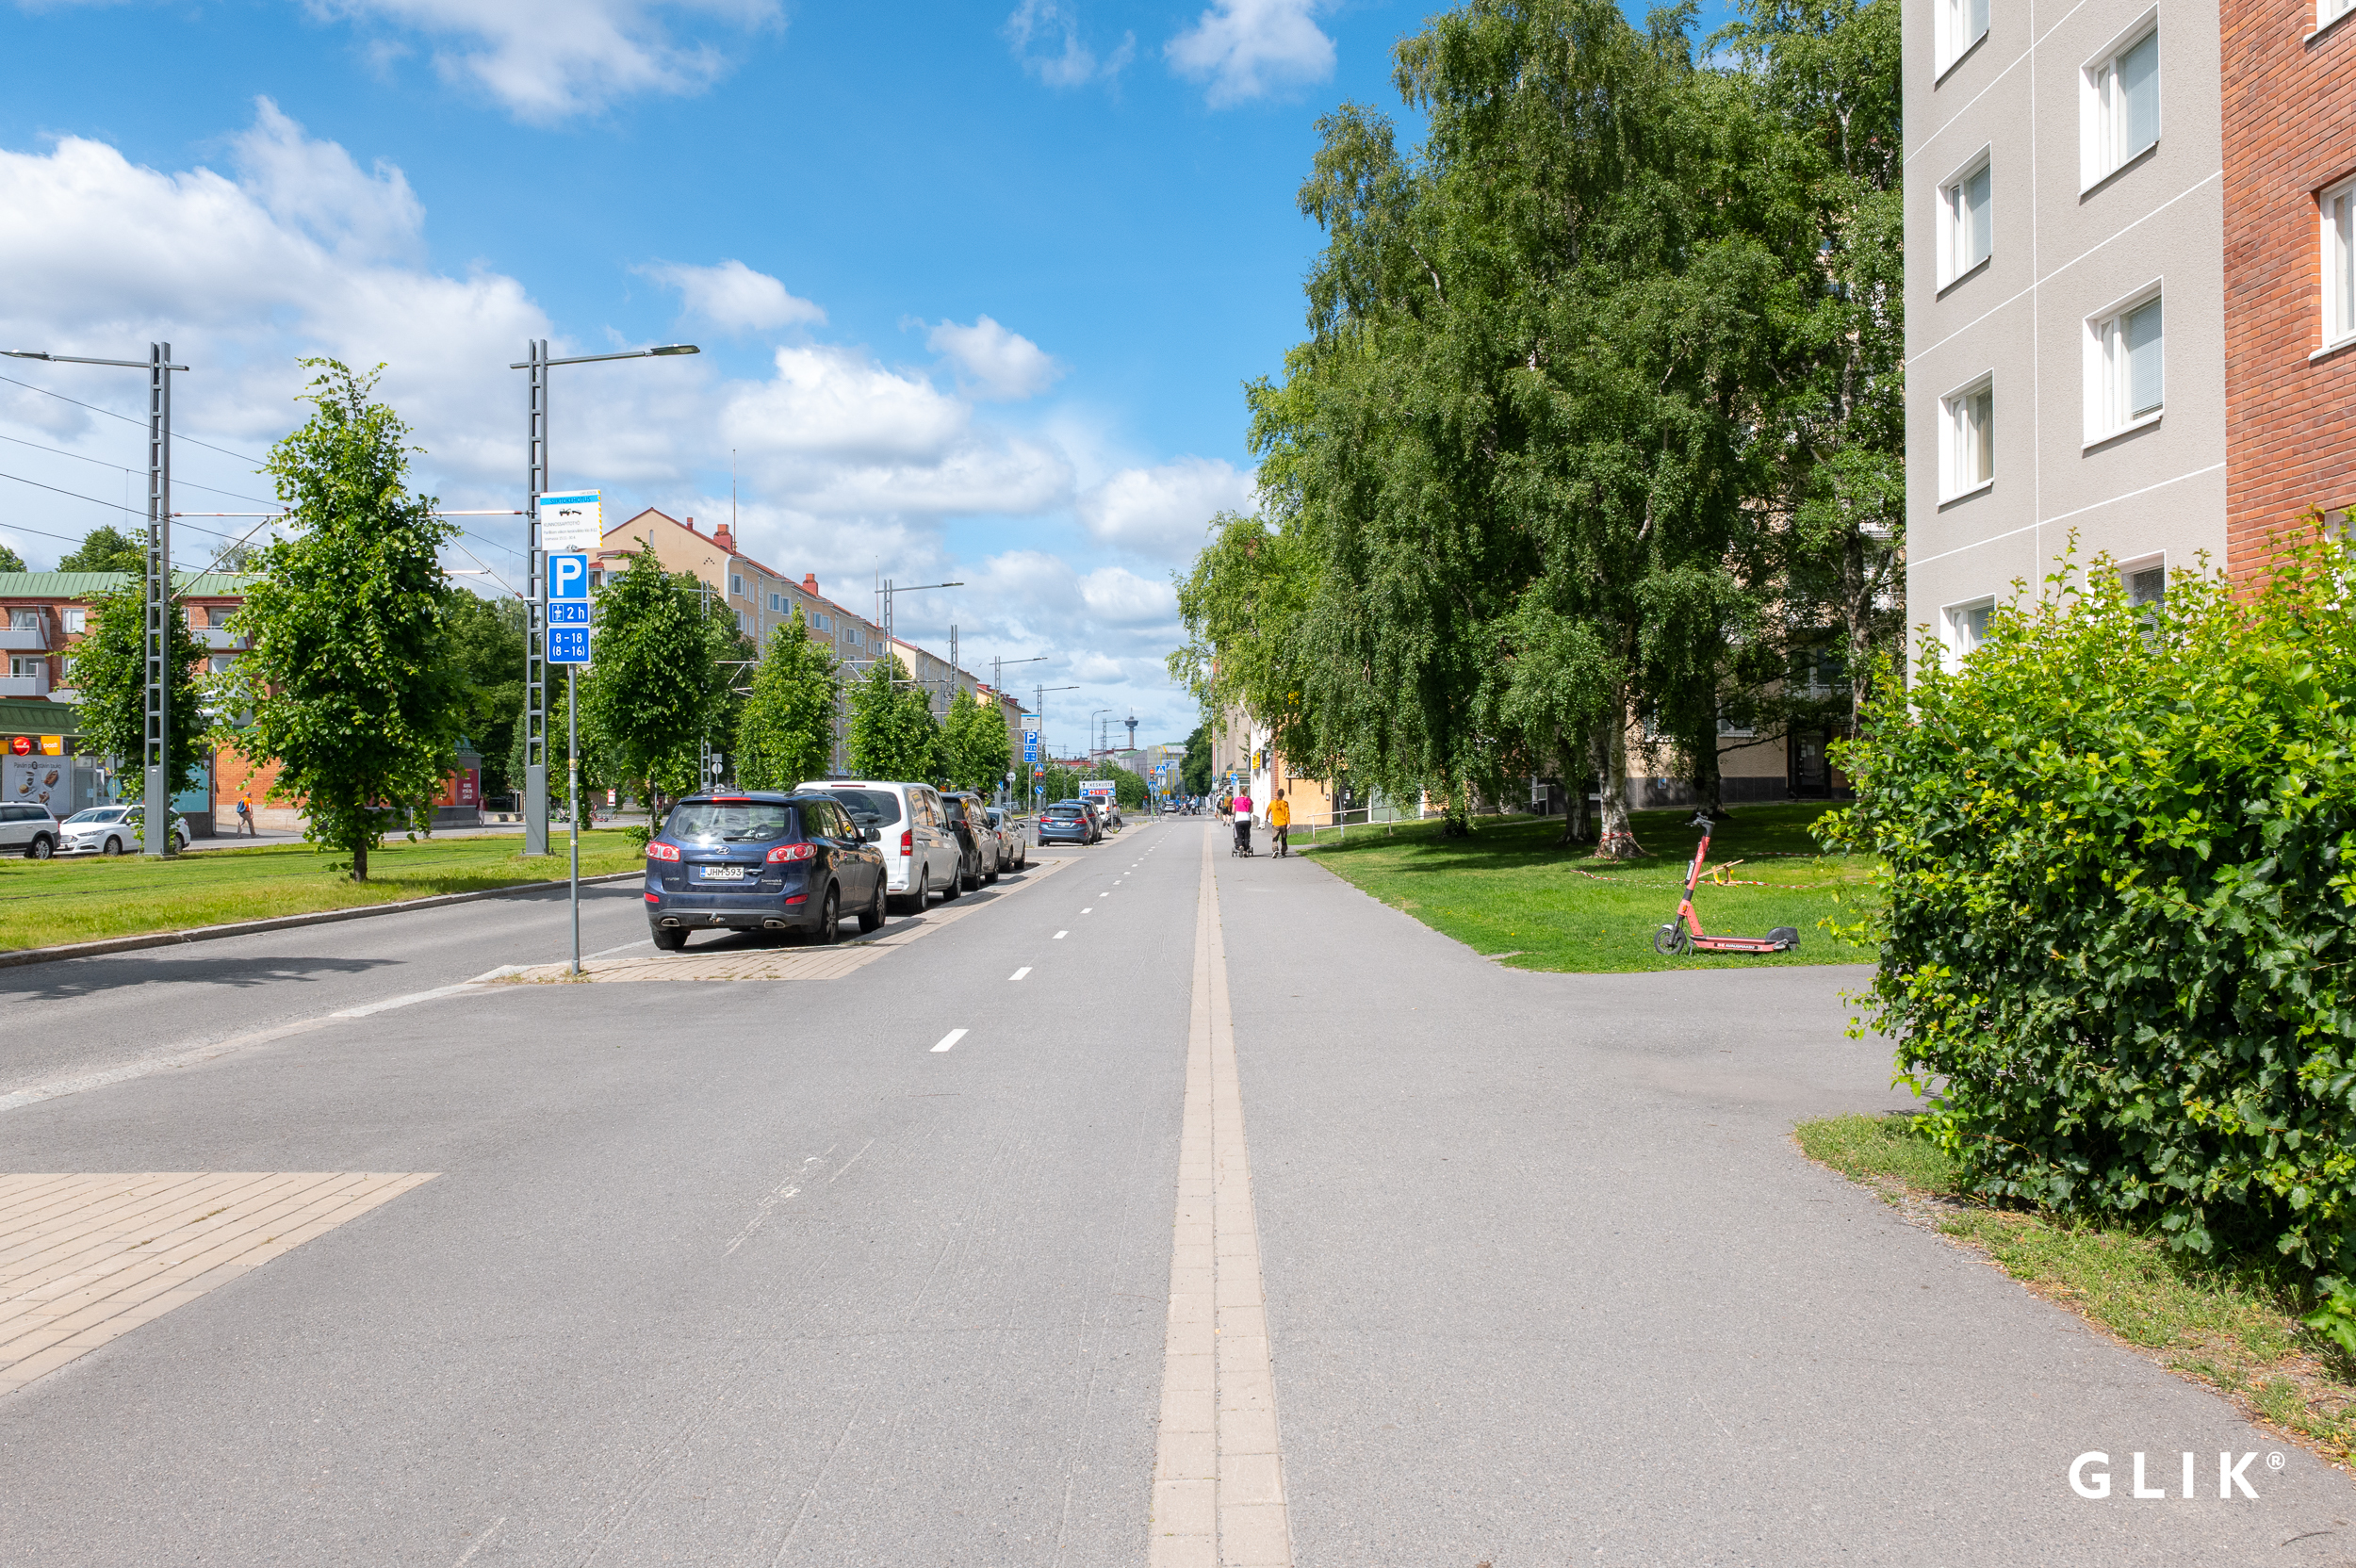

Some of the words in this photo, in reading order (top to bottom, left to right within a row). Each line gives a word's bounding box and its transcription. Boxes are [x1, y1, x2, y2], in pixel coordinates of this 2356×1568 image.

[549, 496, 591, 504] SIIRTOKEHOTUS
[557, 558, 581, 596] P
[567, 607, 574, 619] 2
[578, 606, 584, 619] h
[1027, 732, 1036, 743] P
[707, 868, 743, 876] JHM-593
